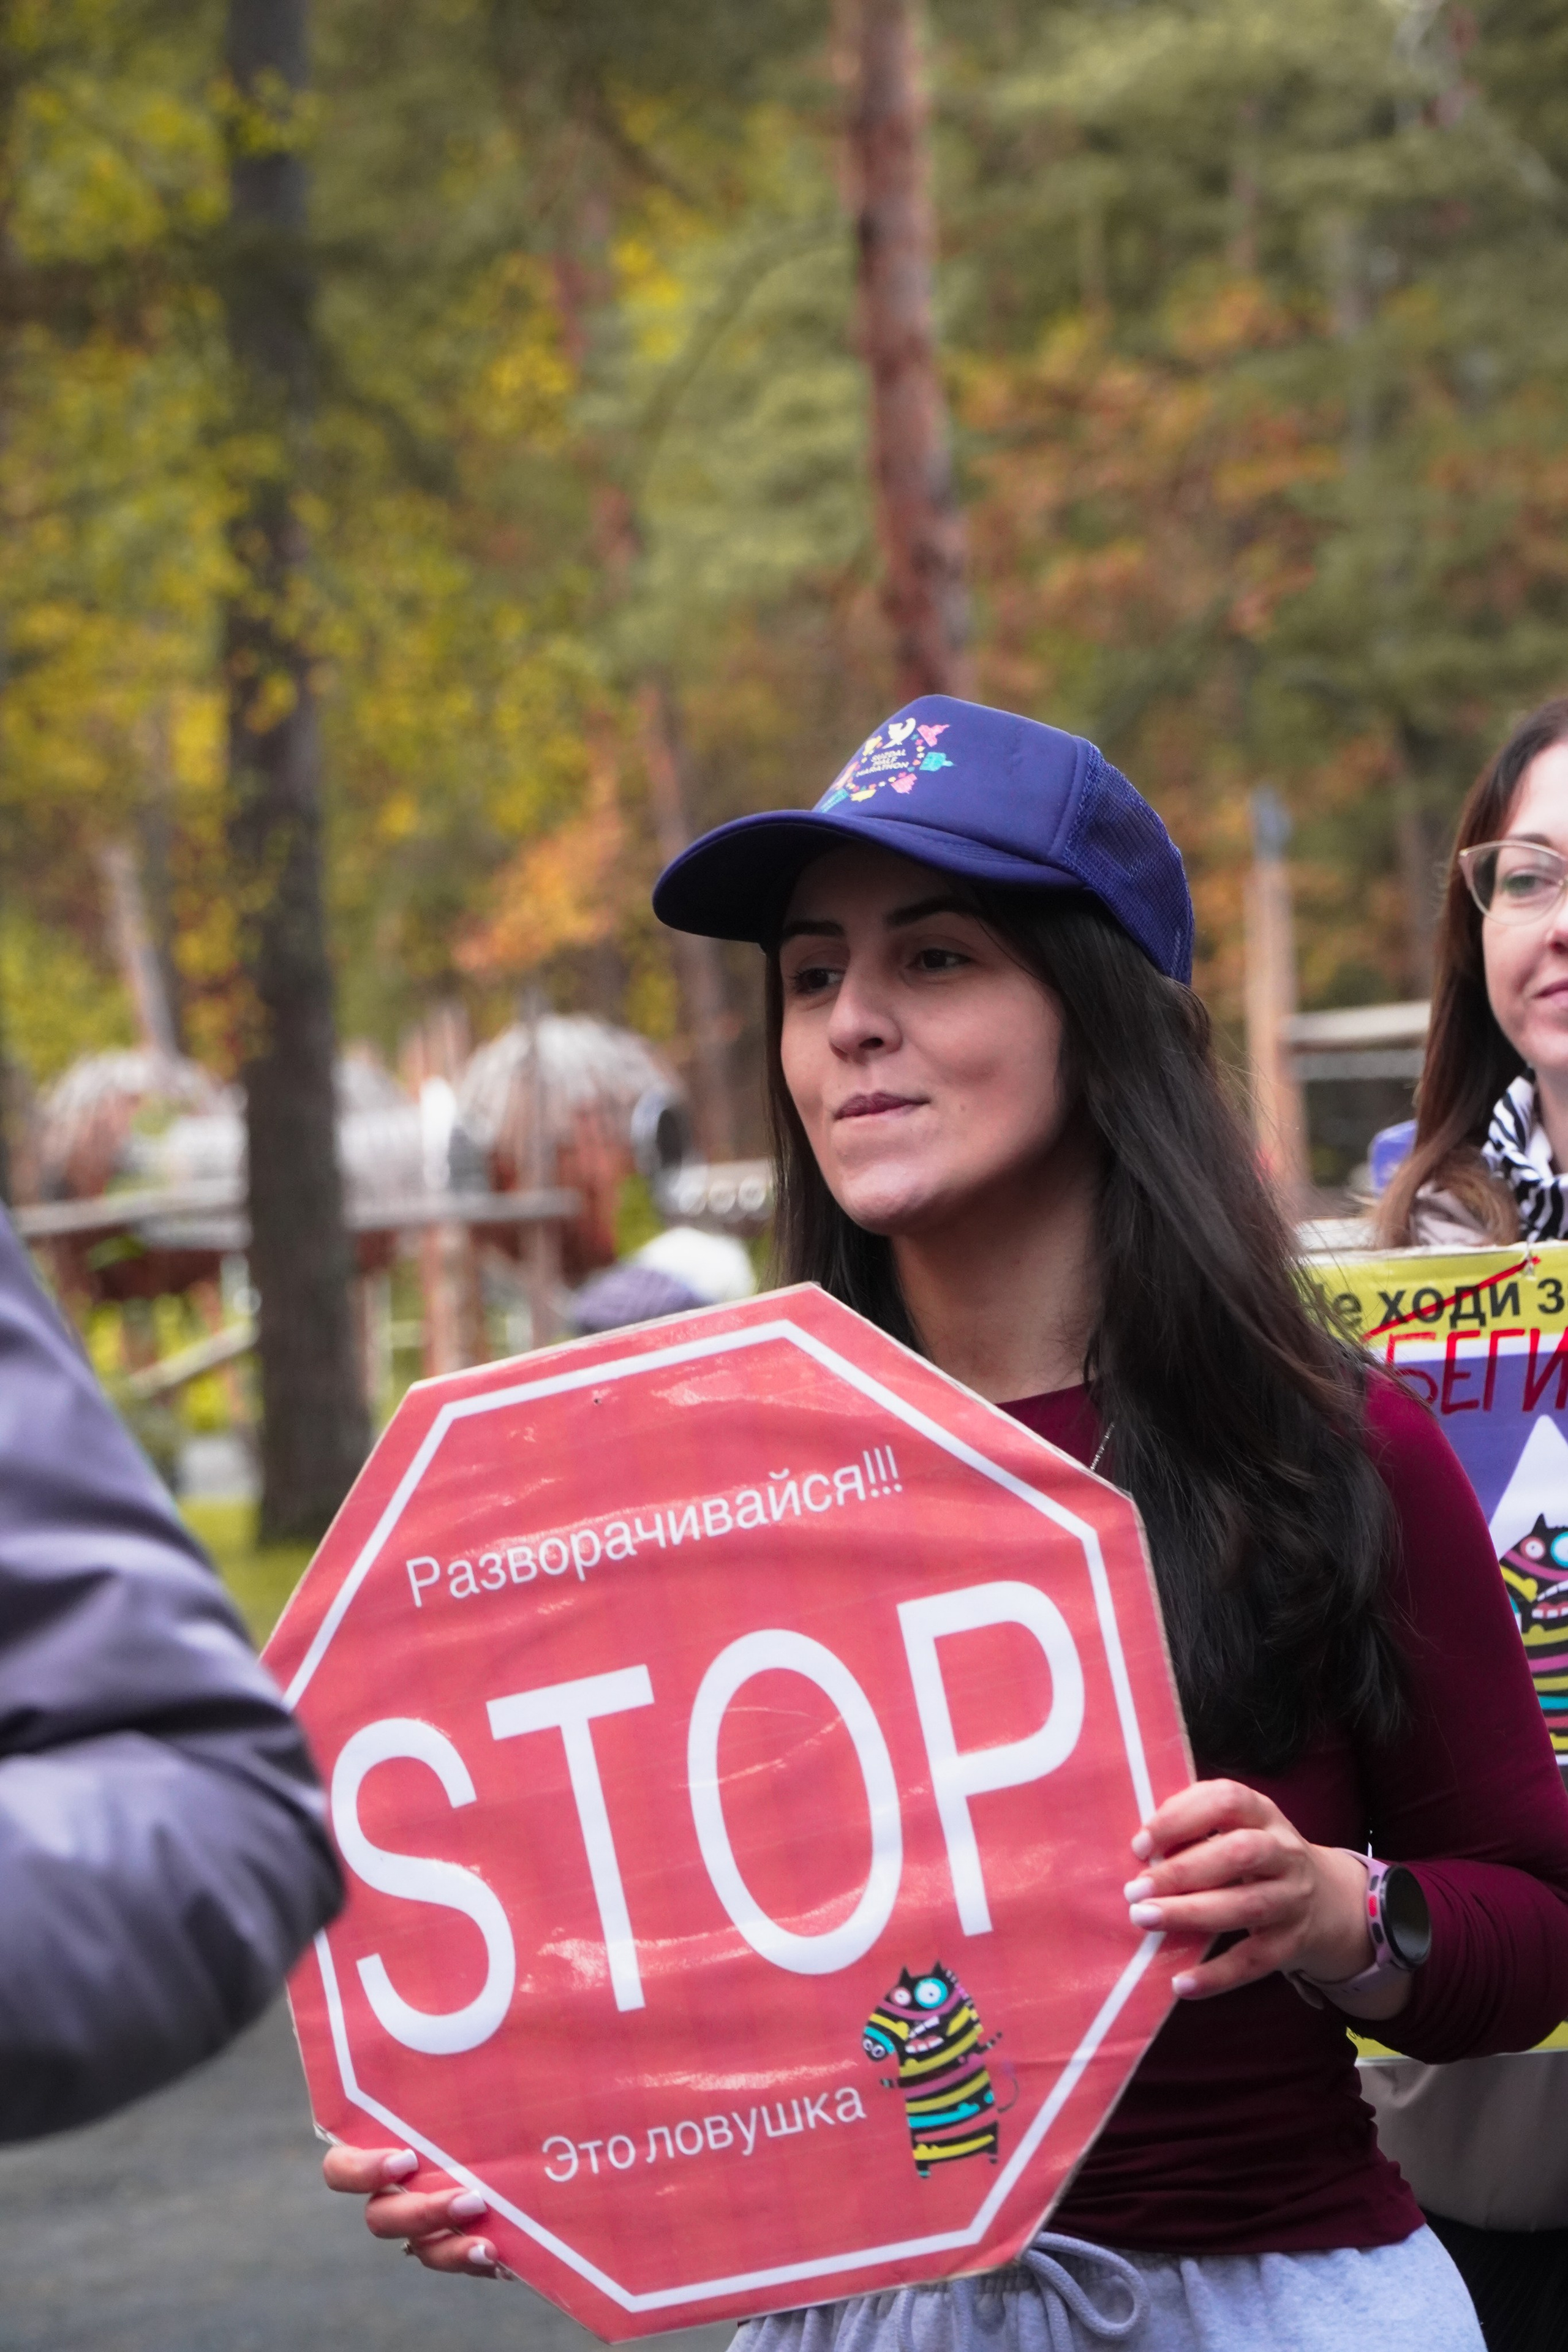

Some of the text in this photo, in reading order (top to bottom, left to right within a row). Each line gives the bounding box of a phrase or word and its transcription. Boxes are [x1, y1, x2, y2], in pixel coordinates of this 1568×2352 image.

[1378, 1281, 1521, 1330] ходи
[1537, 1278, 1568, 1315] з
[1386, 1326, 1568, 1415] БЕГИ
[405, 1444, 903, 1608] Разворачивайся!!!
[330, 1579, 1085, 2056] STOP
[541, 2086, 867, 2182] Это ловушка
